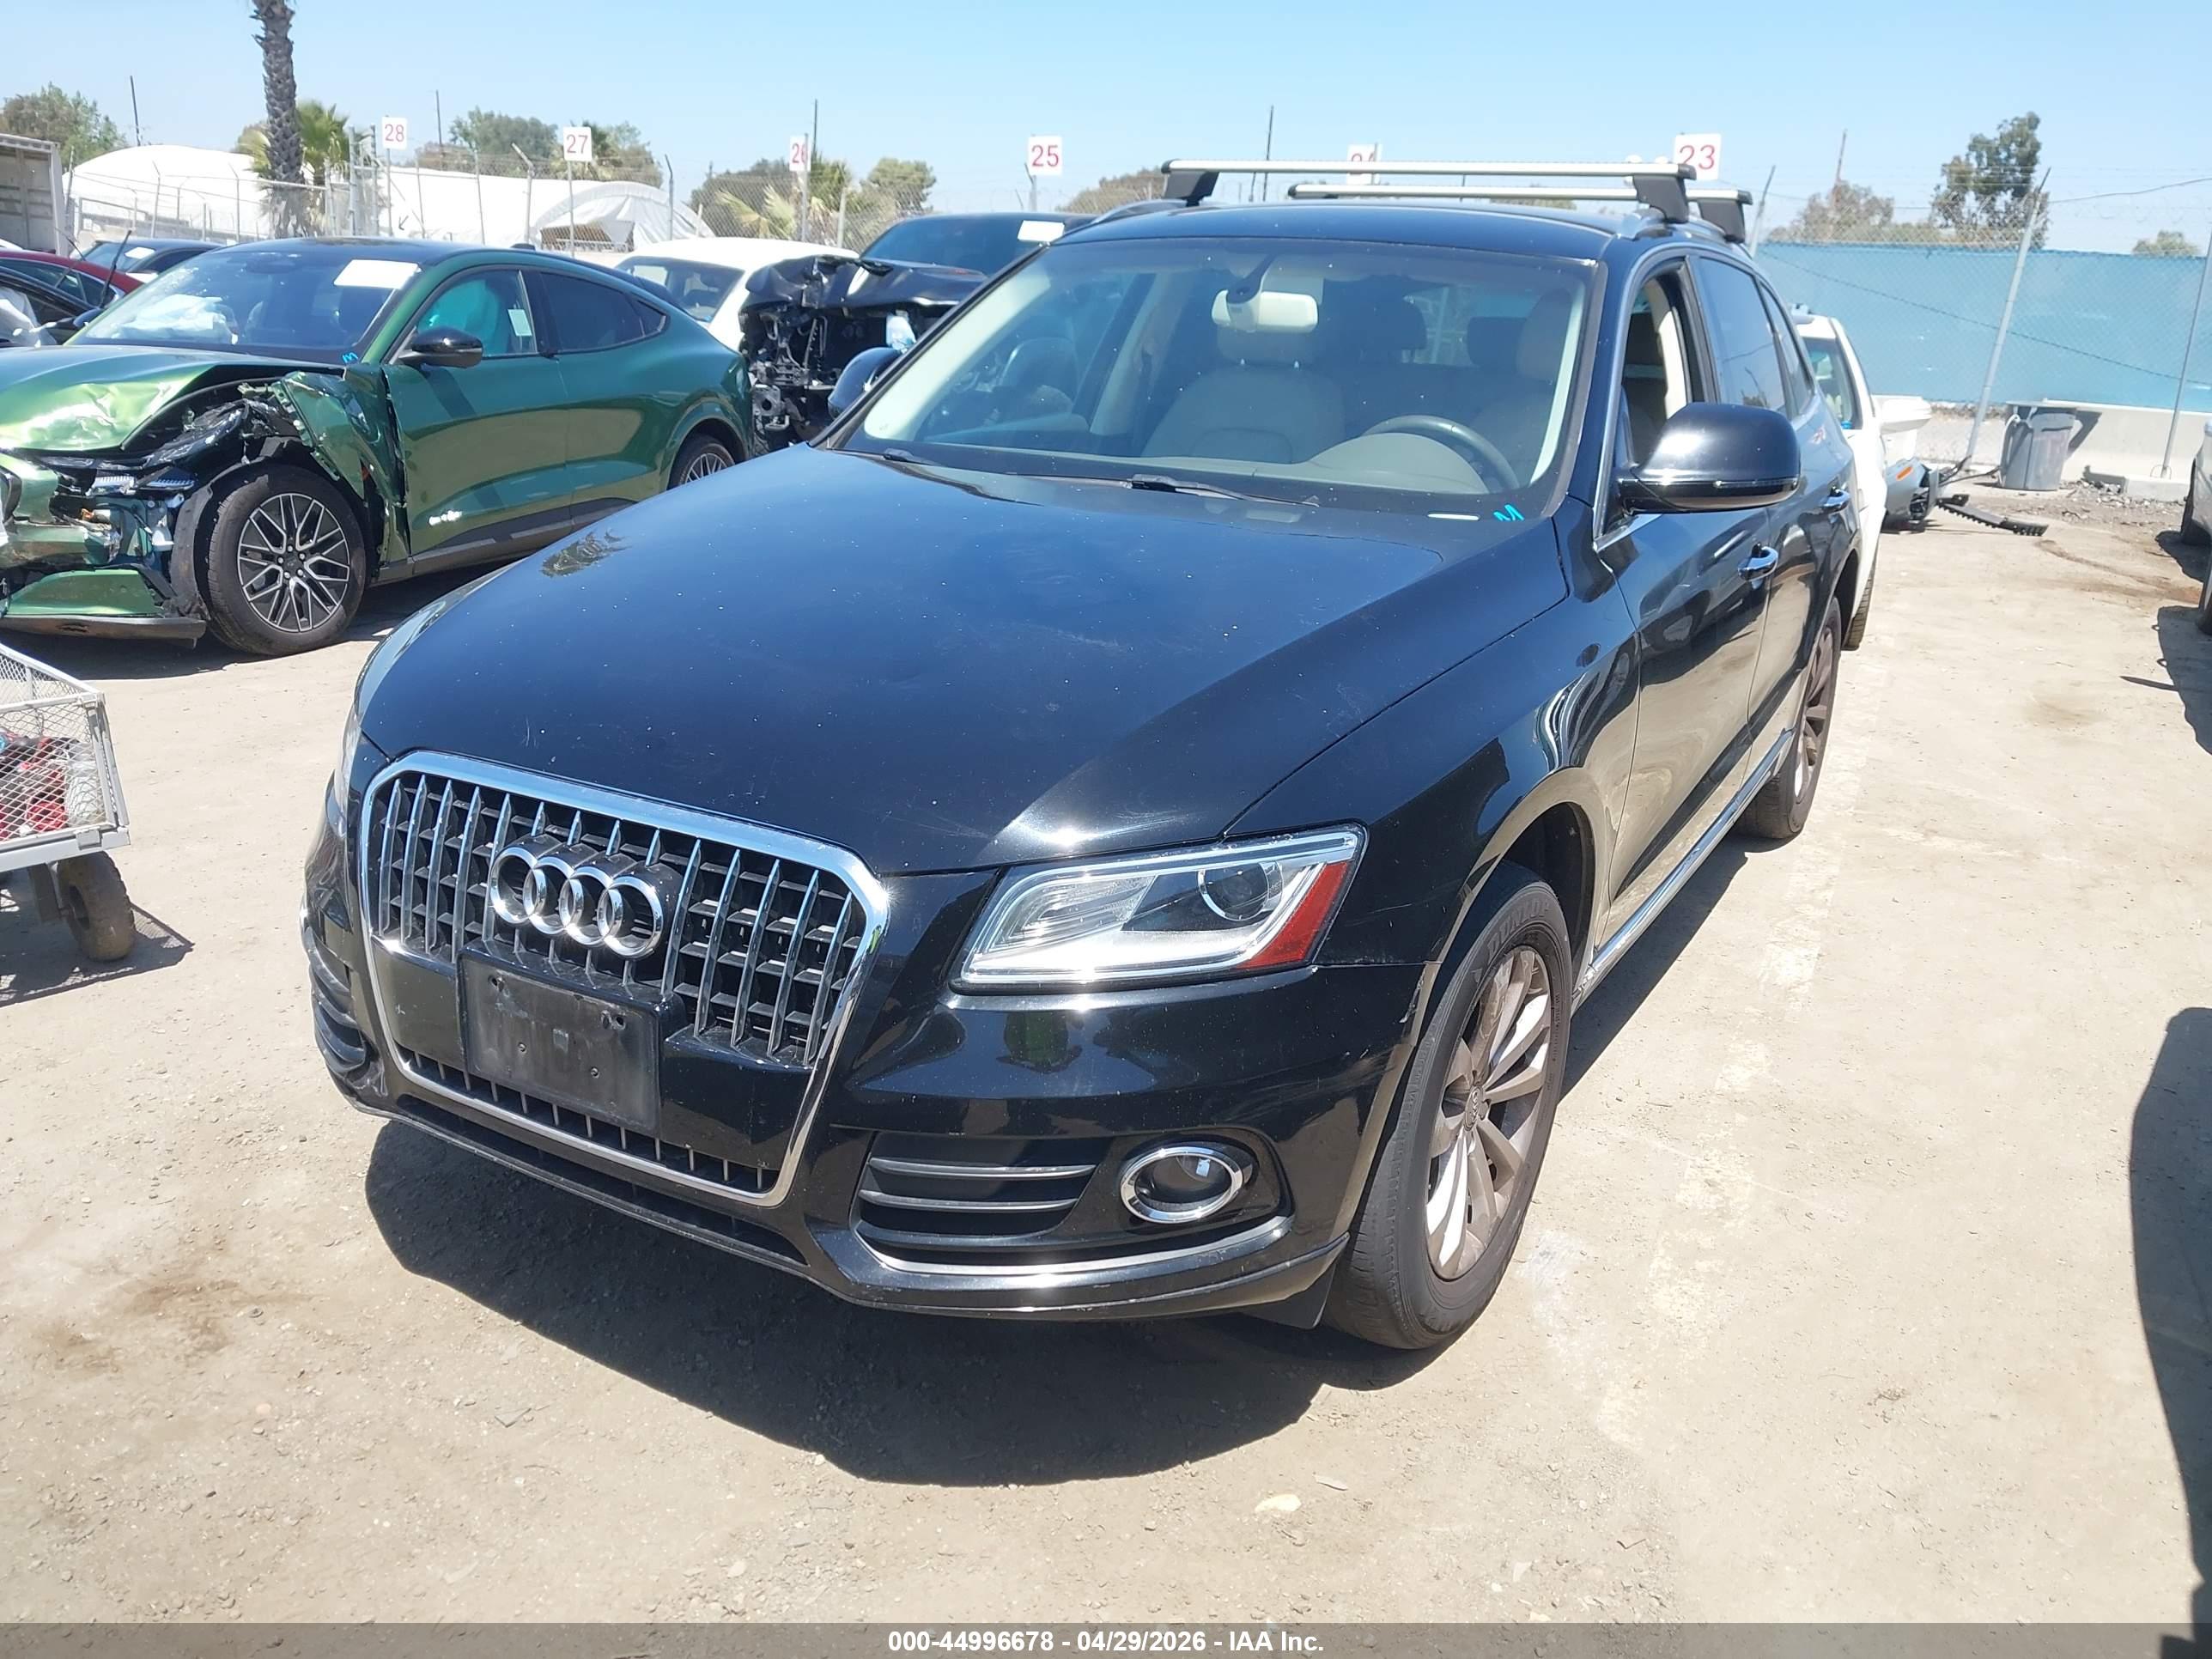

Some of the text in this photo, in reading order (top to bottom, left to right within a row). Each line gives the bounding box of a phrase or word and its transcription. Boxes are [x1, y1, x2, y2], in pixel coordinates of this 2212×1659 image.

[385, 123, 404, 143] 28
[567, 134, 588, 154] 27
[1031, 144, 1059, 167] 25
[1680, 144, 1716, 170] 23
